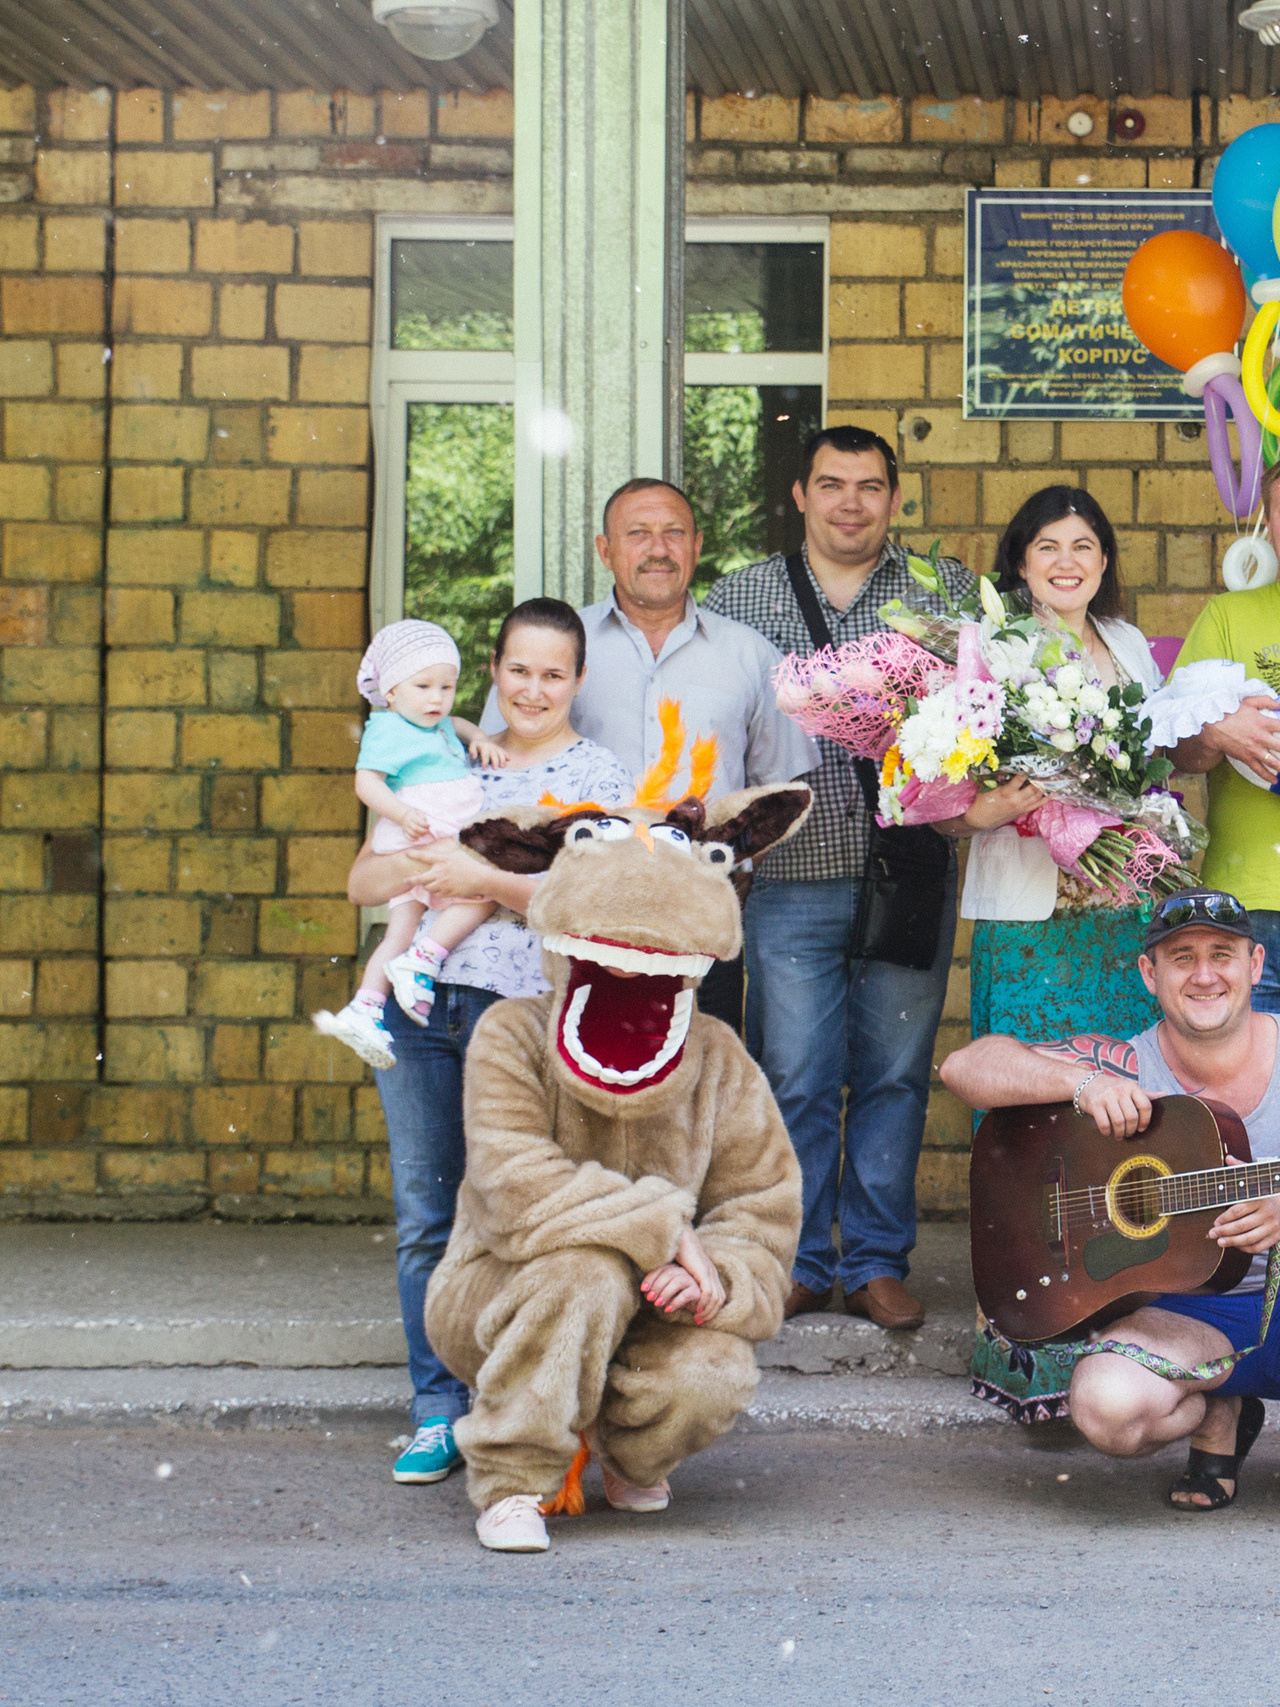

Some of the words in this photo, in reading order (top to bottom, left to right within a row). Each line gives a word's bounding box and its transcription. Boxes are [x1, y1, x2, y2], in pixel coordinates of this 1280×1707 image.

[1021, 212, 1094, 220] МИНИСТЕРСТВО
[1095, 212, 1185, 221] ЗДРАВООХРАНЕНИЯ
[1052, 223, 1128, 231] КРАСНОЯРСКОГО
[1130, 223, 1154, 231] КРАЯ
[1049, 240, 1138, 248] ГОСУДАРСТВЕННОЕ
[1050, 299, 1123, 318] ДЕТСК
[1058, 347, 1147, 364] КОРПУС
